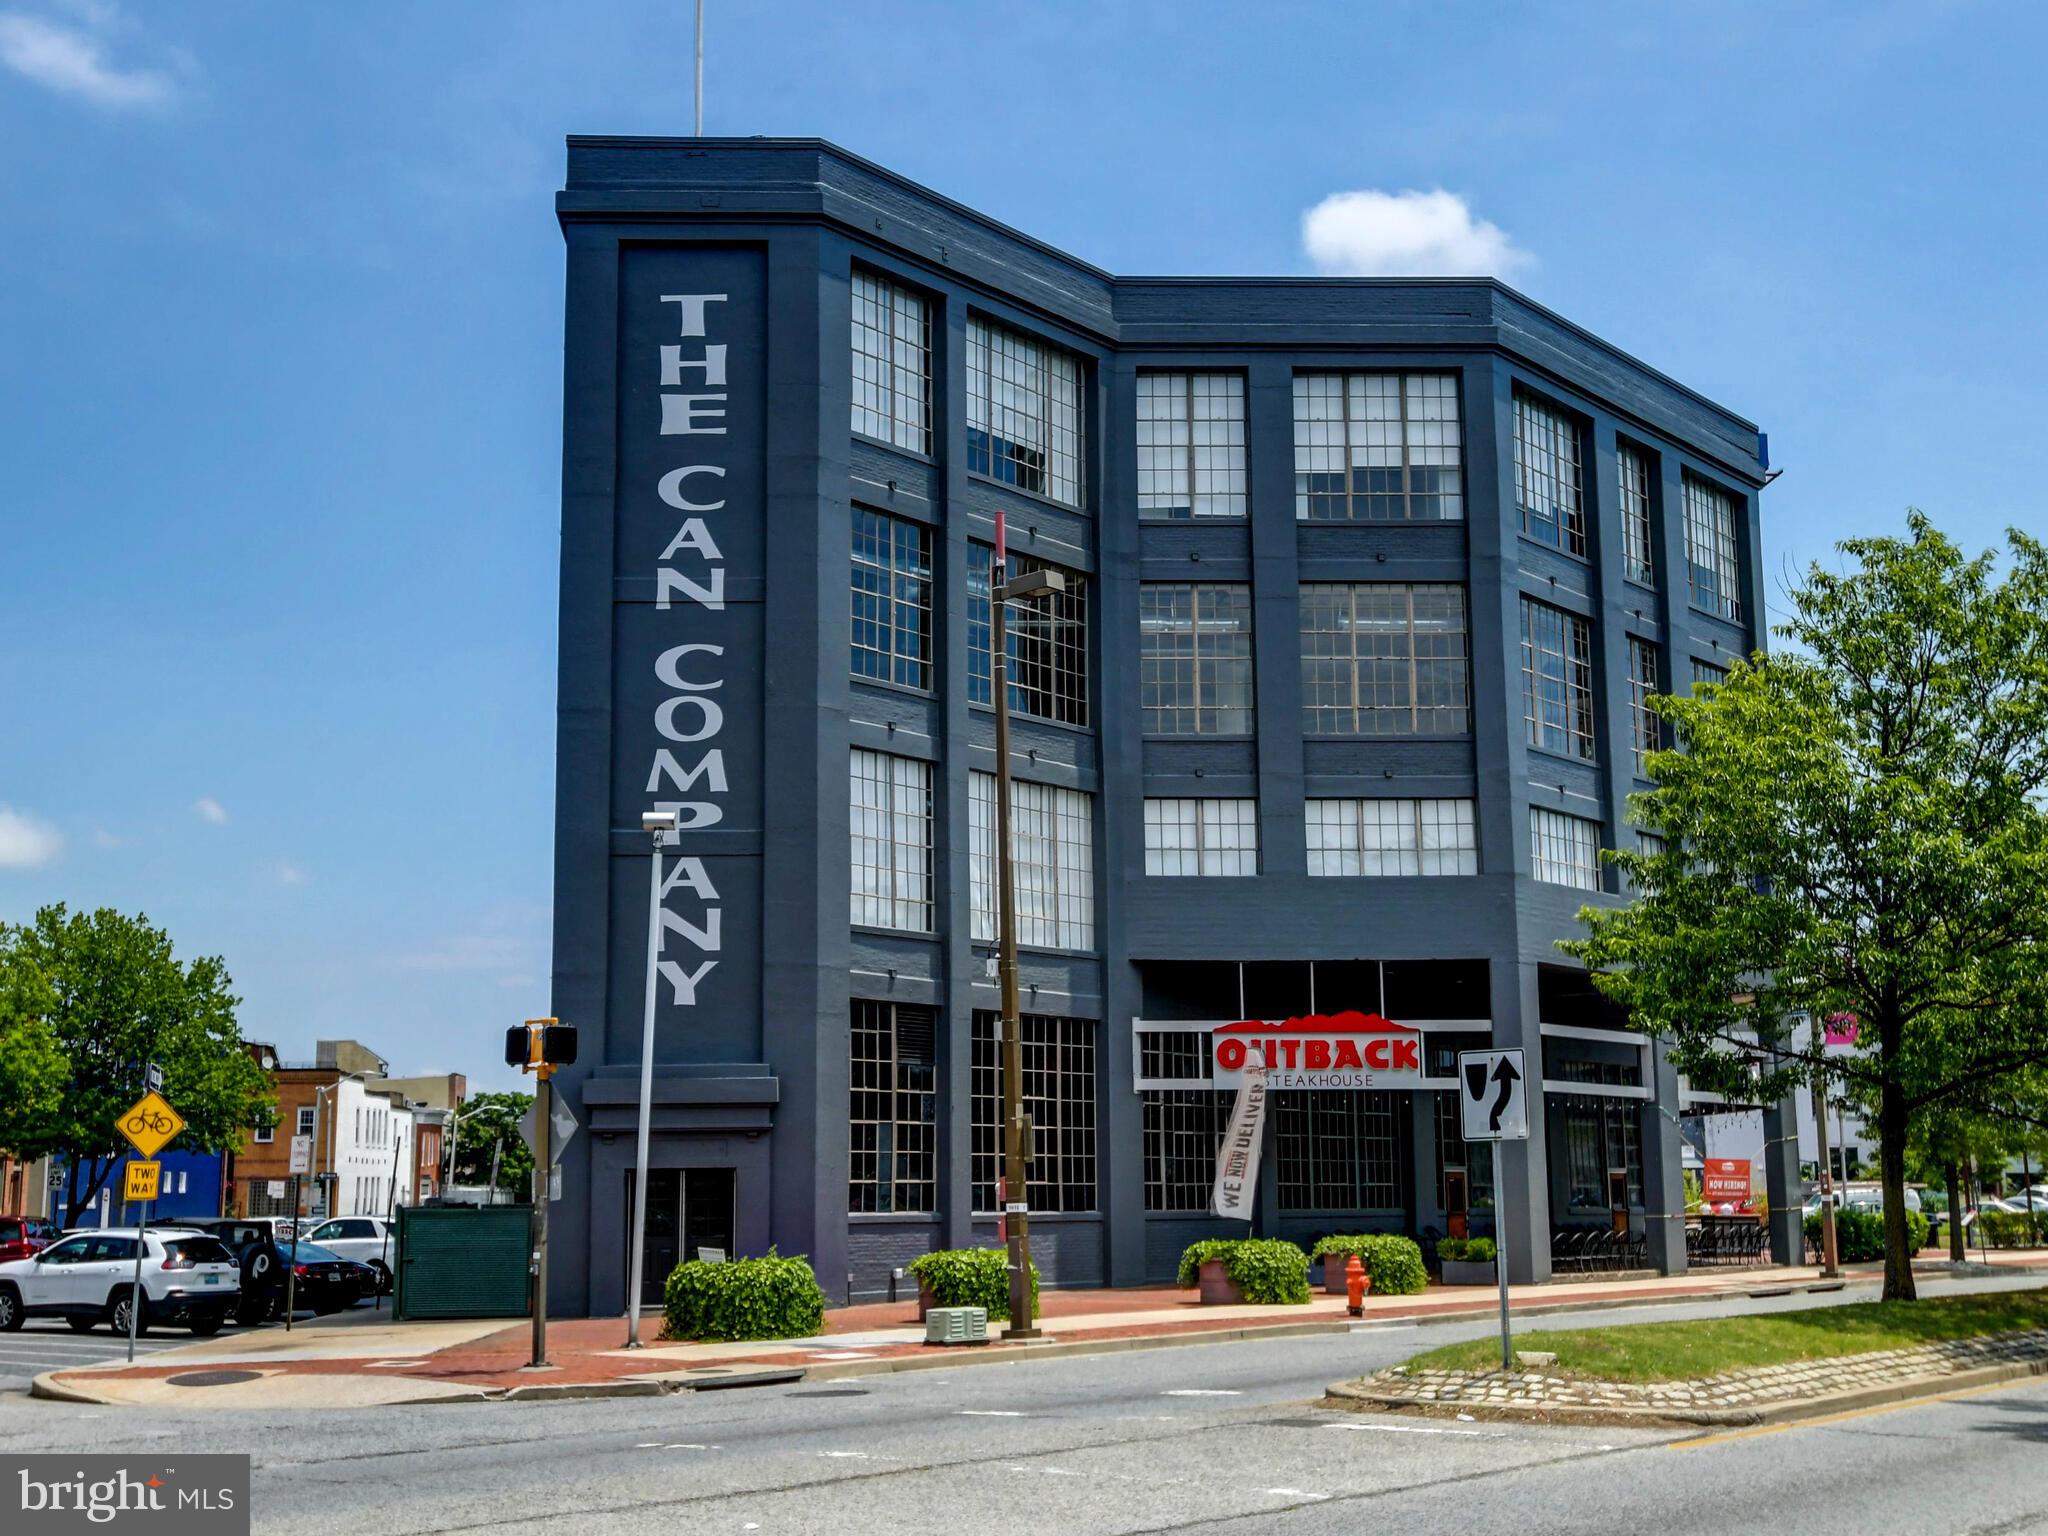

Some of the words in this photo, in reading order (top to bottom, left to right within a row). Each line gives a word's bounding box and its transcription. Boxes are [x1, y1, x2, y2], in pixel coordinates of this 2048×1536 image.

[660, 293, 728, 435] THE
[655, 465, 727, 610] CAN
[645, 643, 729, 1006] COMPANY
[1216, 1038, 1419, 1070] OUTBACK
[134, 1168, 155, 1178] TWO
[1227, 1151, 1248, 1177] NOW
[49, 1176, 62, 1186] 25
[131, 1183, 154, 1193] WAY
[1709, 1180, 1723, 1190] NOW
[1224, 1181, 1242, 1209] WE
